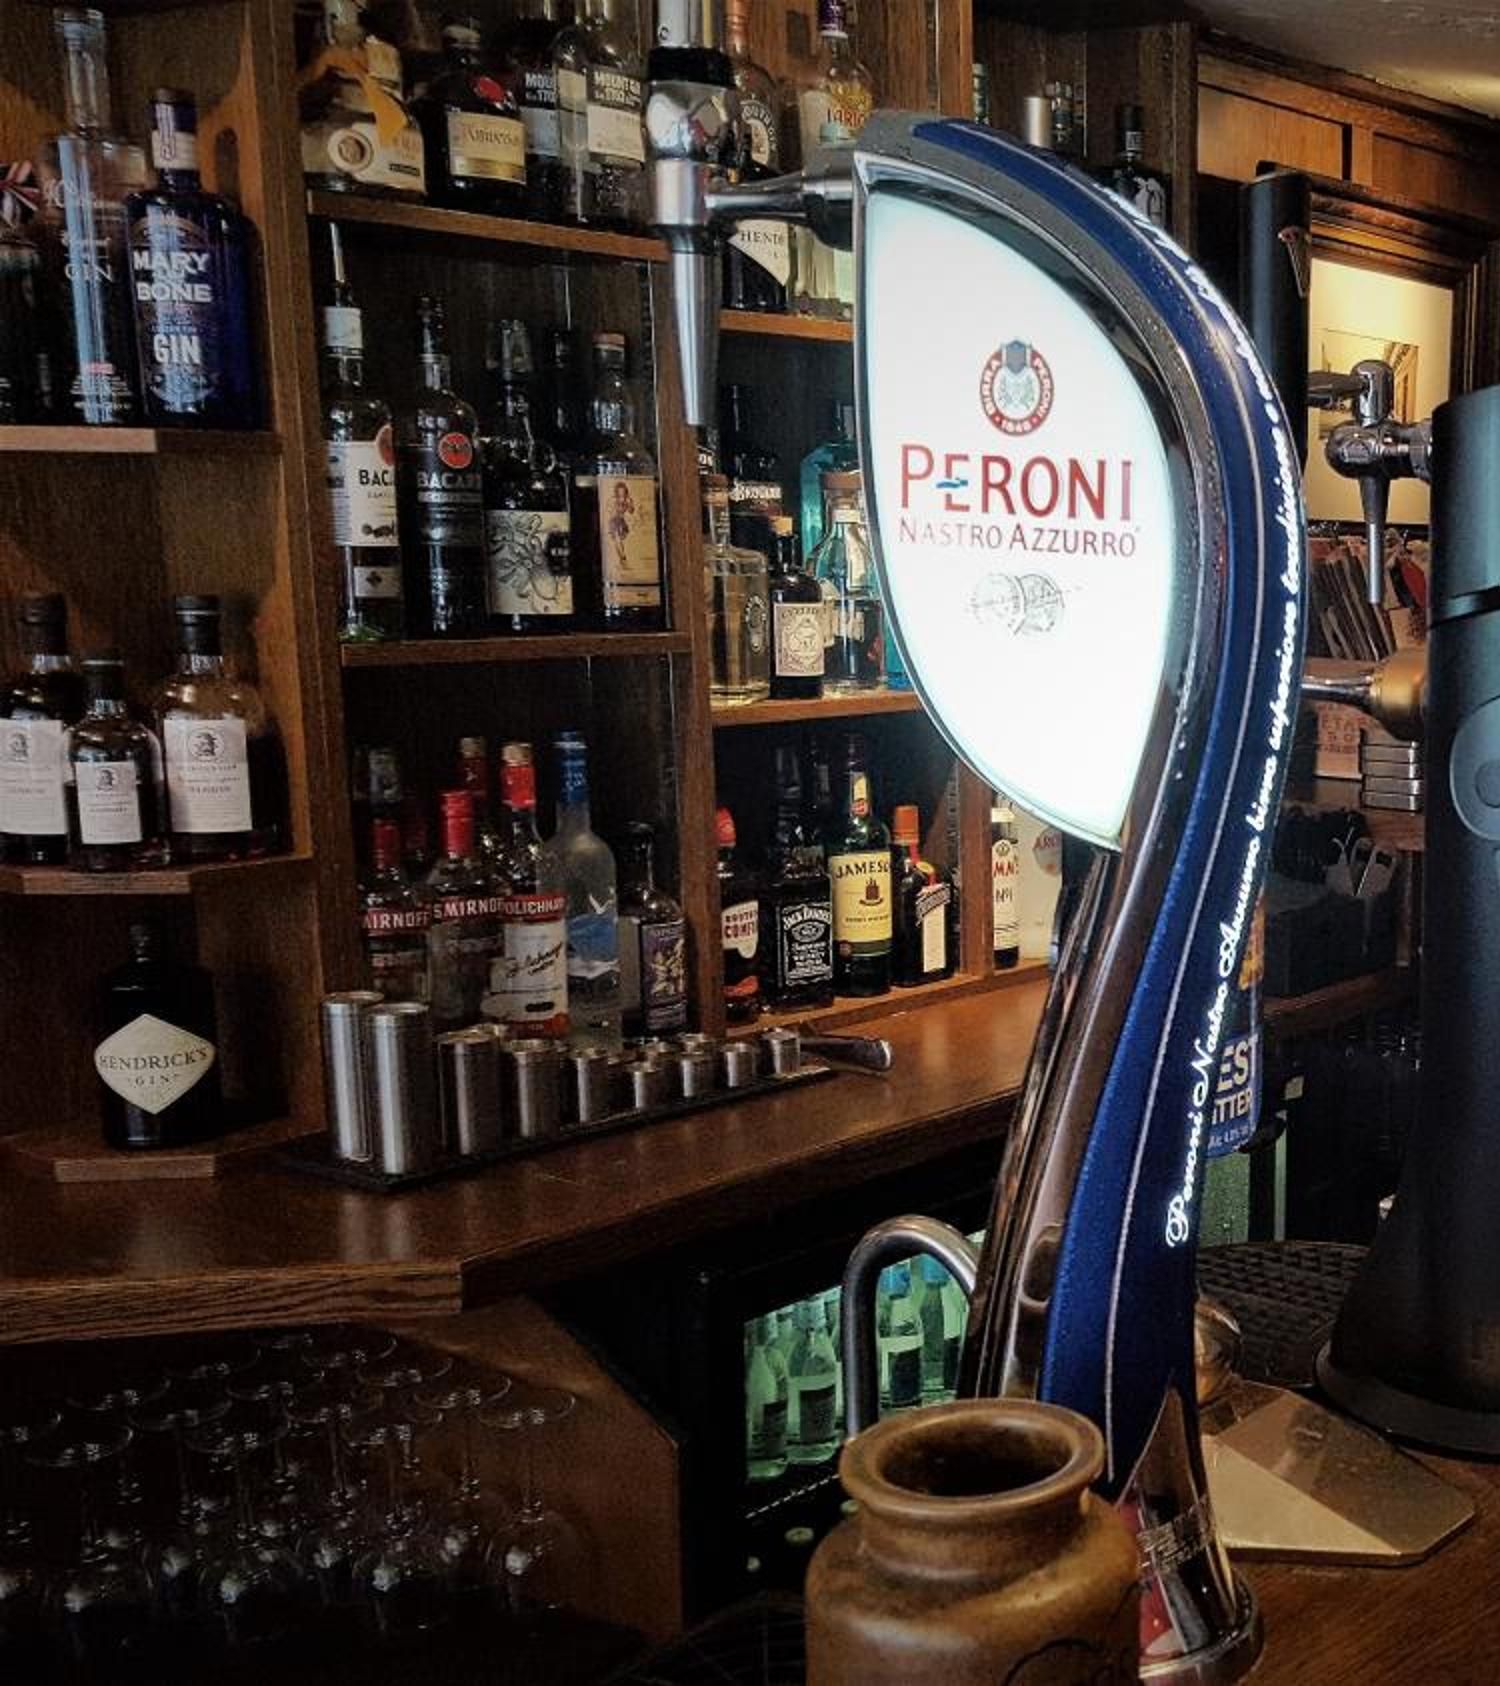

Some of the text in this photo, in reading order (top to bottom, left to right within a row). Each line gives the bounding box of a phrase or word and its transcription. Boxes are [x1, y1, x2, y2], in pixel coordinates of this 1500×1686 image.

[133, 251, 209, 273] MARY
[136, 283, 212, 303] BONE
[153, 334, 201, 365] GIN
[900, 443, 1132, 522] PERONI
[900, 517, 1137, 558] NASTRO AZZURRO
[1216, 1034, 1258, 1093] EST
[1166, 1112, 1203, 1247] Peroni
[1192, 982, 1228, 1107] Nastro
[1212, 1087, 1253, 1125] ITTER
